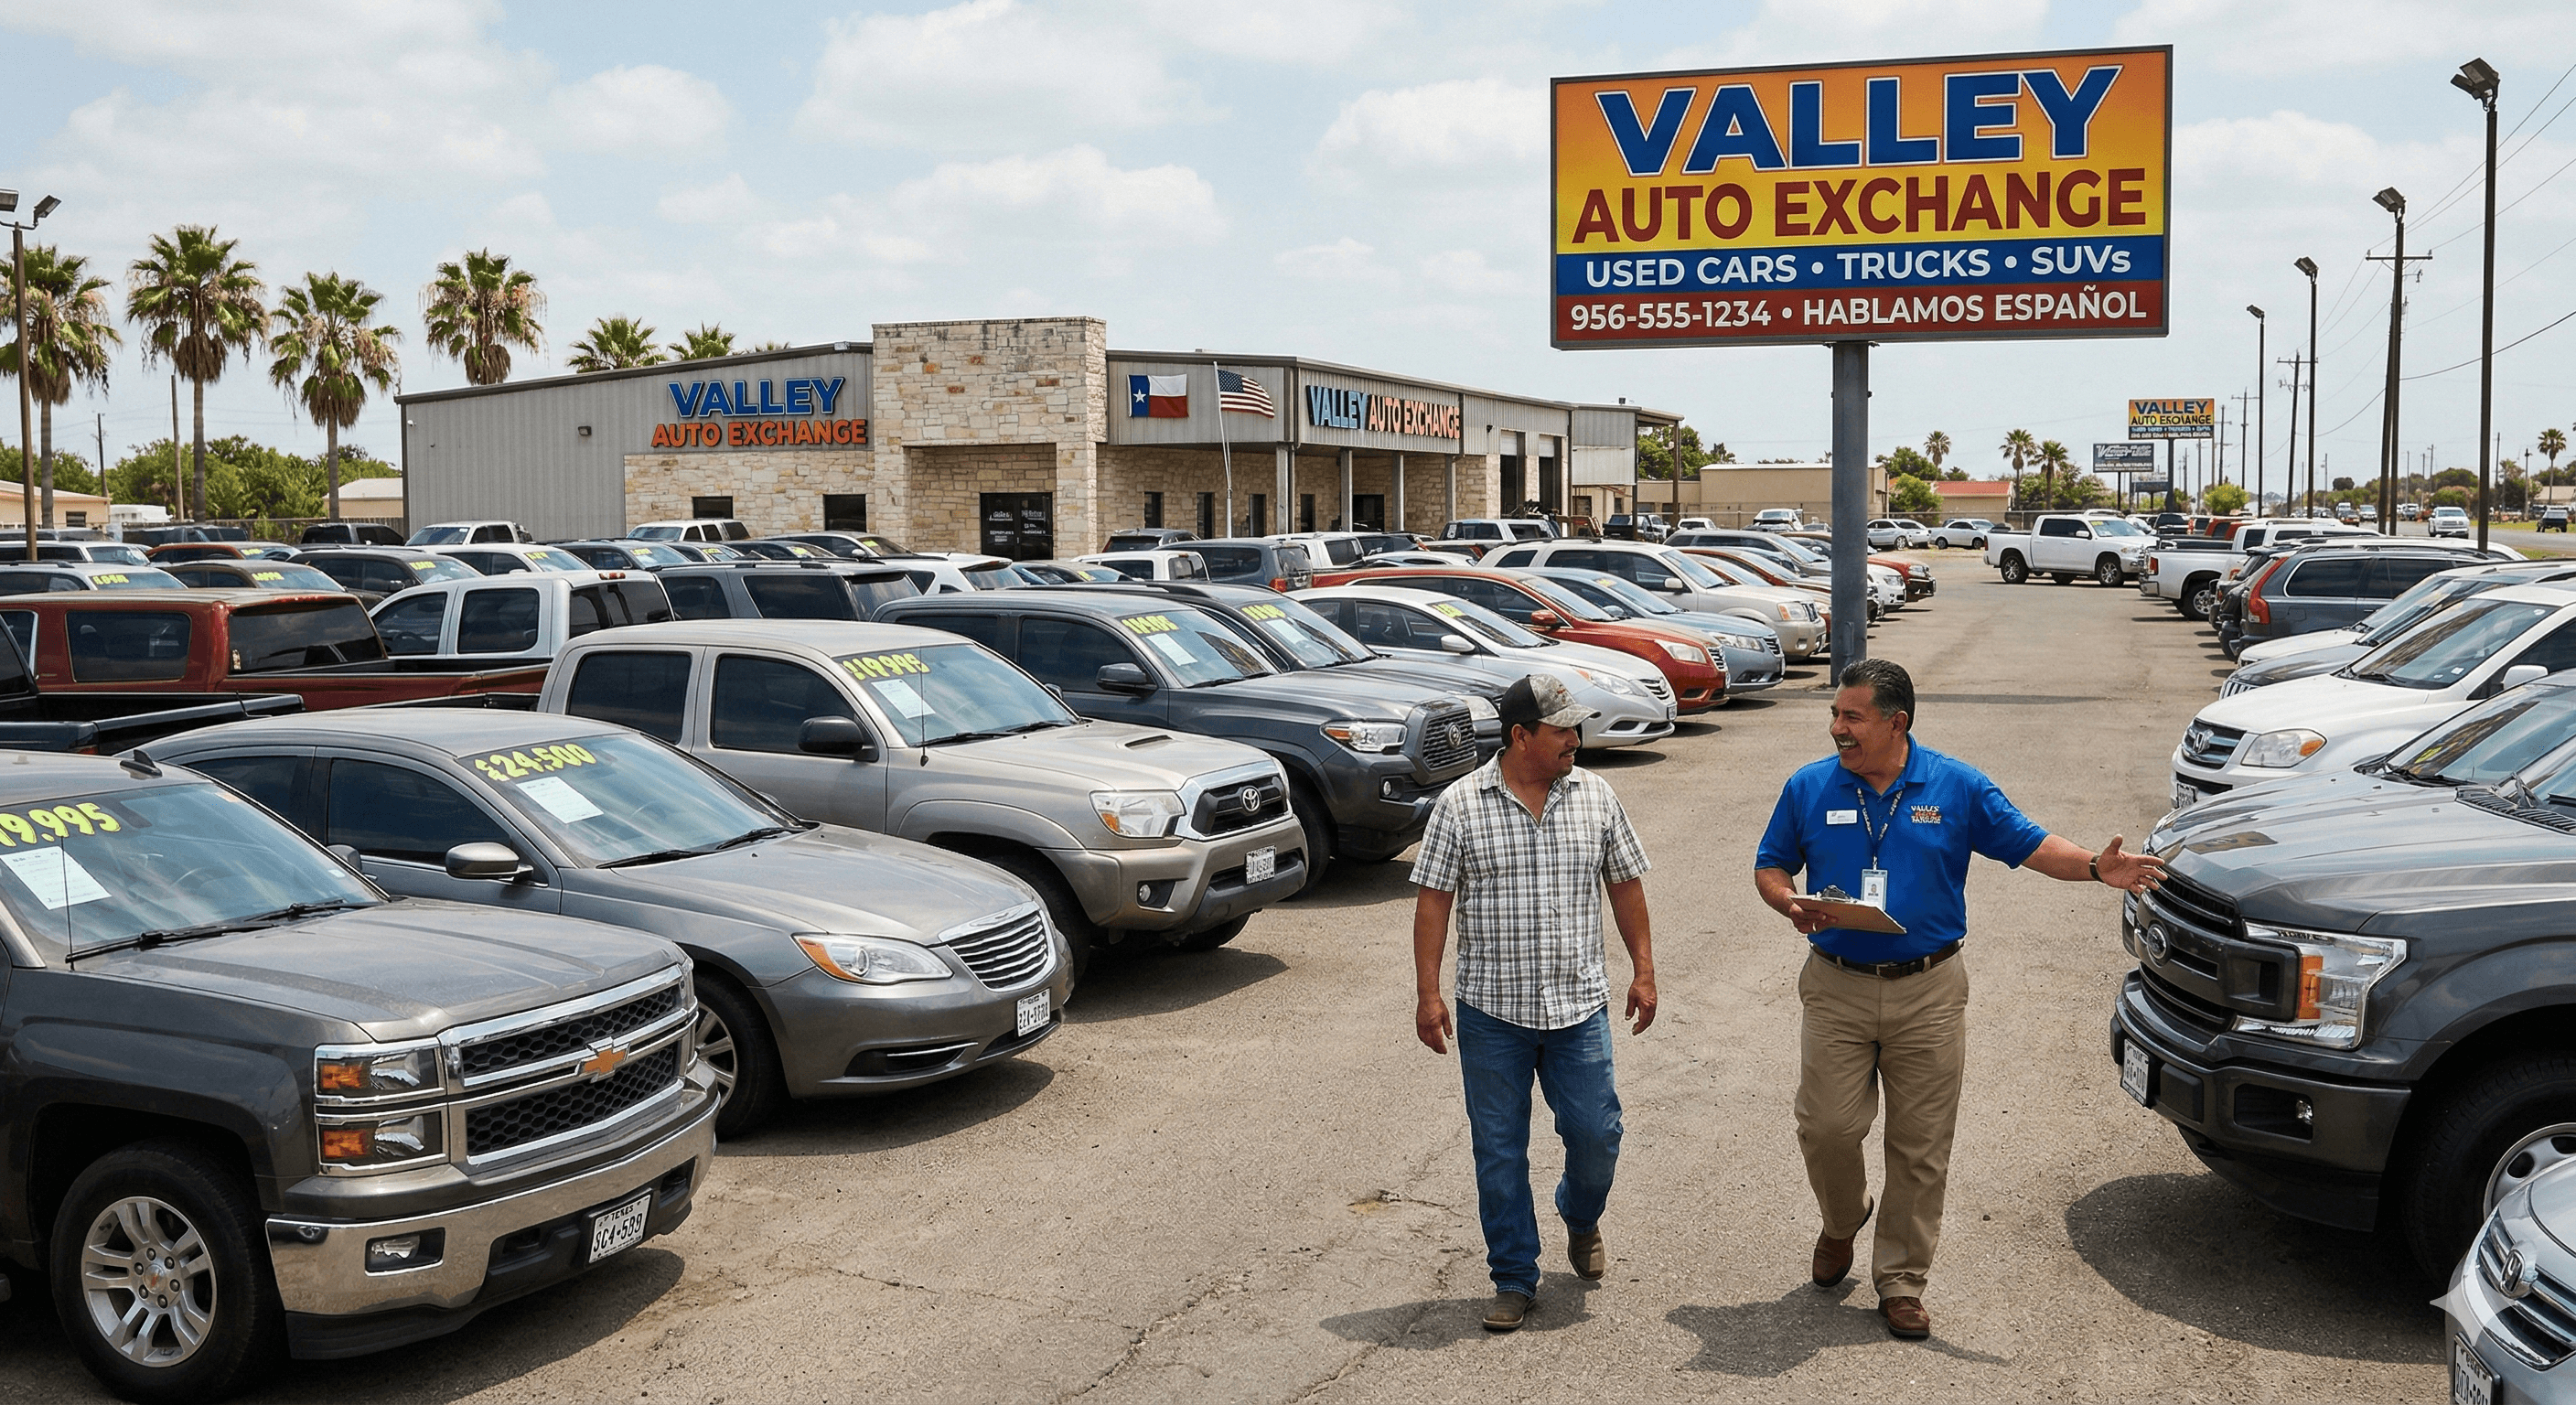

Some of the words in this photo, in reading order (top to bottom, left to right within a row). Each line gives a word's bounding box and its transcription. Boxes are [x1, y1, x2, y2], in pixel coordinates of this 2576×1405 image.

[1594, 65, 2123, 177] VALLEY
[1572, 183, 1753, 244] AUTO
[1774, 168, 2147, 237] EXCHANGE
[1586, 259, 1686, 288] USED
[1697, 254, 1797, 284] CARS
[1837, 249, 1991, 280] TRUCKS
[2031, 245, 2131, 274] SUVs
[1570, 299, 1772, 330] 956-555-1234
[1804, 295, 1985, 326] HABLAMOS
[1995, 284, 2147, 320] ESPAÑOL
[668, 377, 844, 418] VALLEY
[1307, 385, 1368, 431] VALLEY
[1368, 394, 1401, 433] AUTO
[1404, 400, 1460, 439] EXCHANGE
[2134, 401, 2207, 414] VALLEY
[650, 423, 721, 447] AUTO
[727, 419, 867, 445] EXCHANGE
[2131, 415, 2157, 425] AUTO
